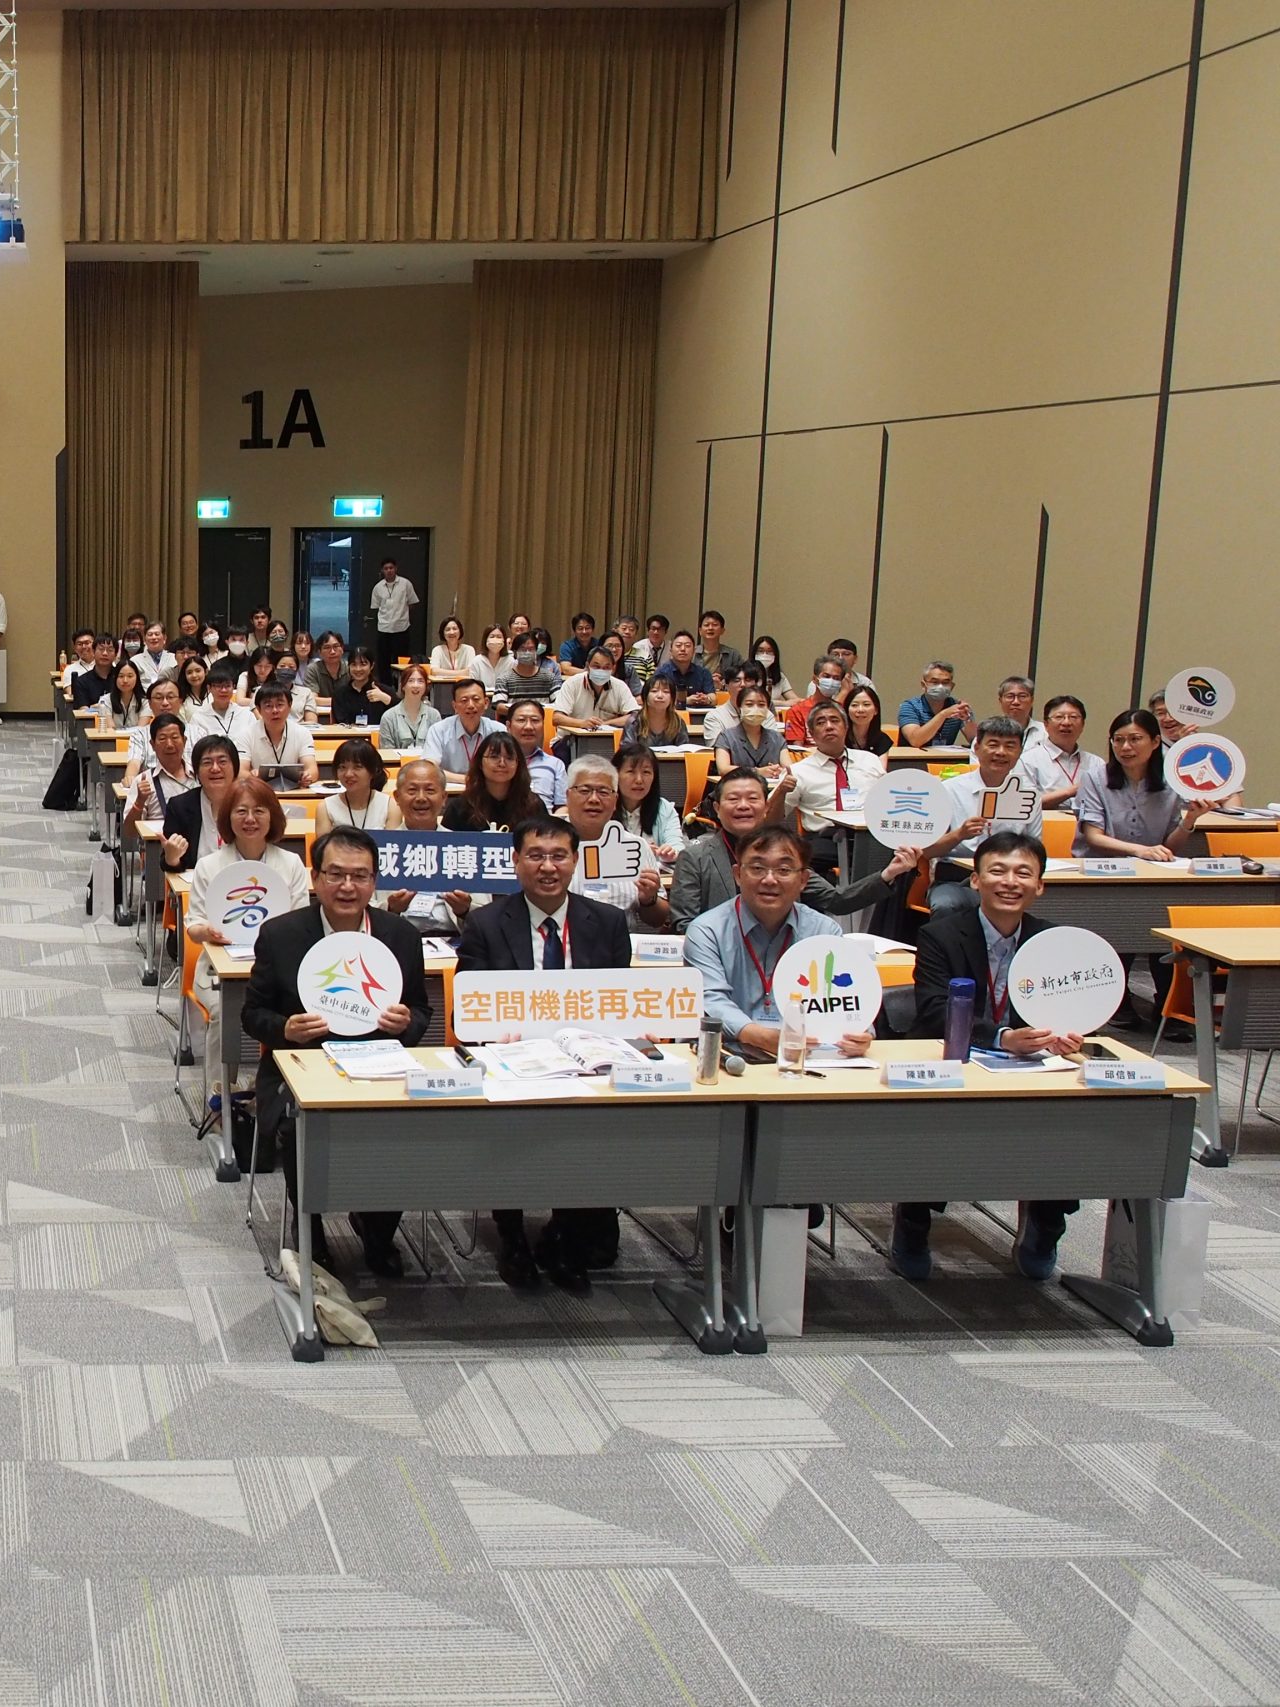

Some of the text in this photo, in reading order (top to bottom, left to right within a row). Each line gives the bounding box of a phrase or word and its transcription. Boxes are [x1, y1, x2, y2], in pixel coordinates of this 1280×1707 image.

[240, 389, 326, 449] 1A
[880, 819, 934, 831] 臺東縣政府
[1040, 964, 1114, 990] 新北市政府
[319, 994, 370, 1017] 臺中市政府
[460, 986, 698, 1022] 空間機能再定位
[906, 1070, 936, 1079] 陳建華
[1104, 1070, 1136, 1080] 邱信智
